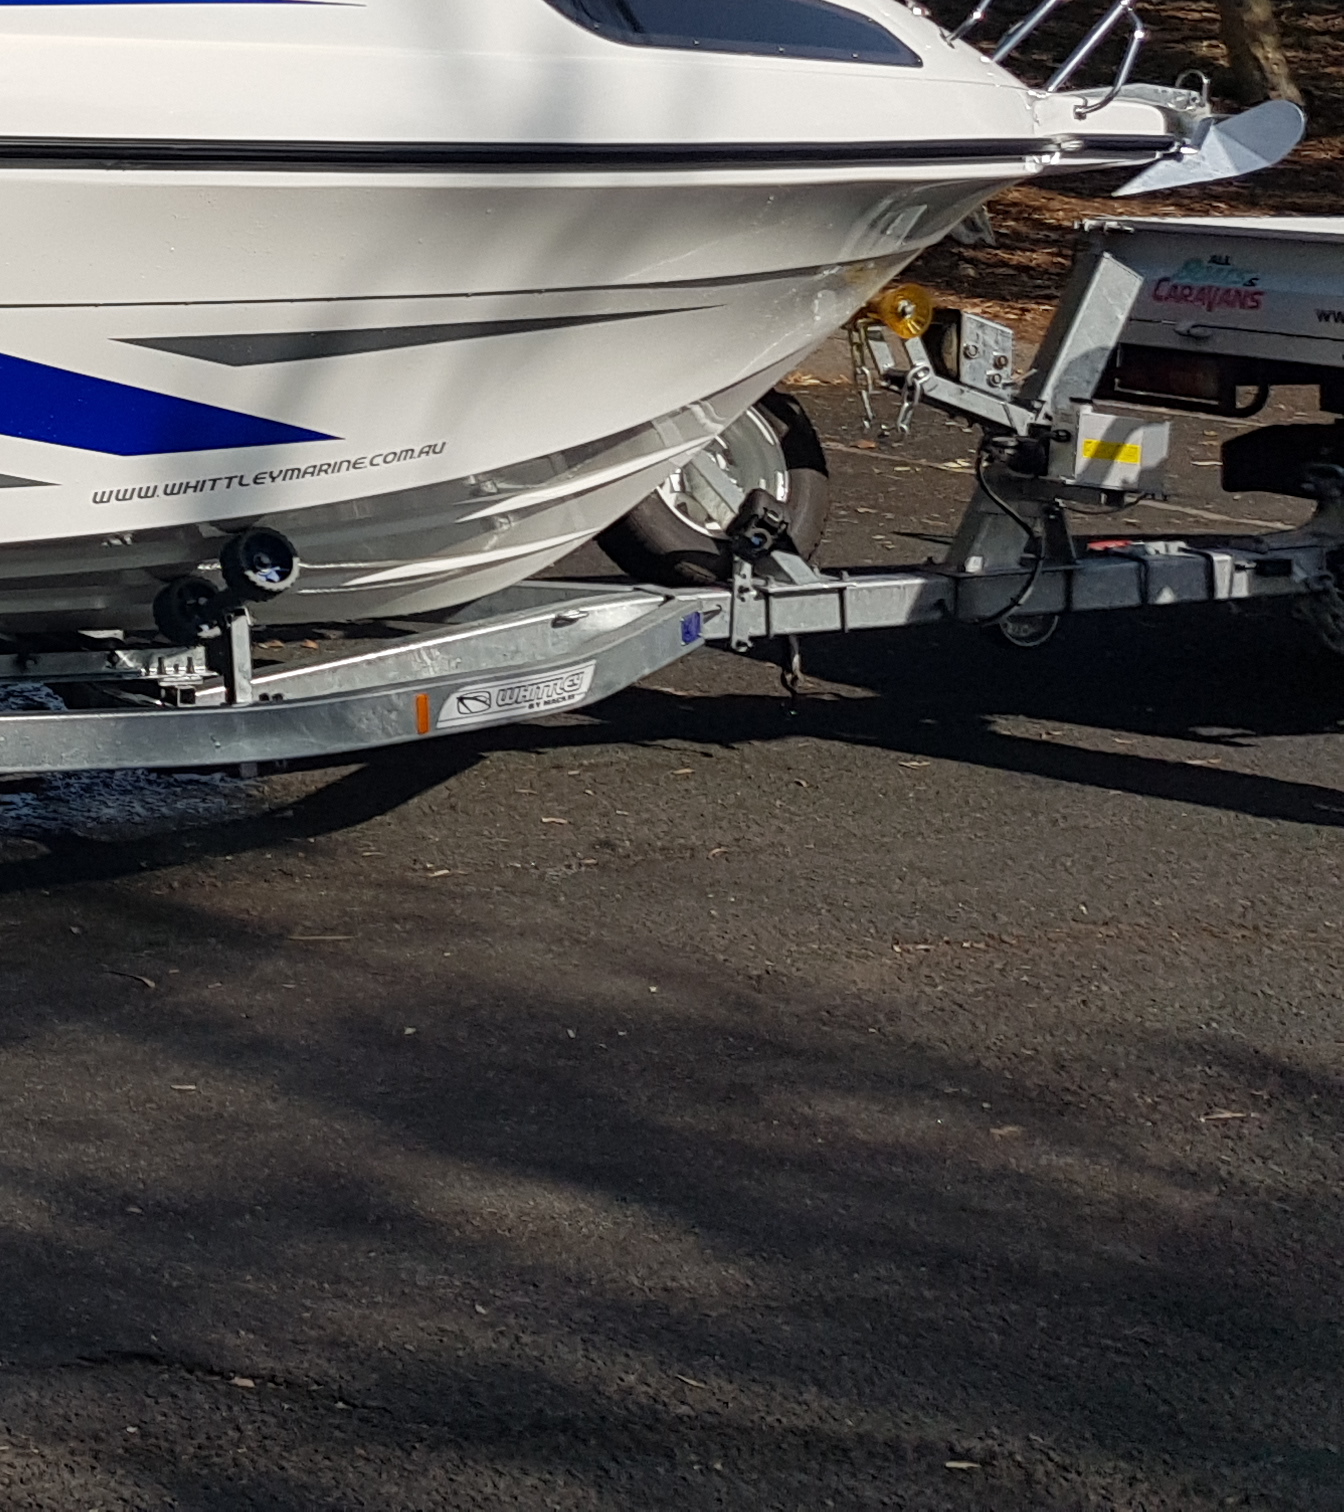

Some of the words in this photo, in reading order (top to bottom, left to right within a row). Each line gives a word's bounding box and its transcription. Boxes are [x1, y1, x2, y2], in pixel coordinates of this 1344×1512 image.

[1152, 276, 1266, 312] CARAVANS
[92, 441, 447, 504] WWW.WHITTLEYMARINE.COM.AU
[496, 671, 585, 707] WHITTLEY
